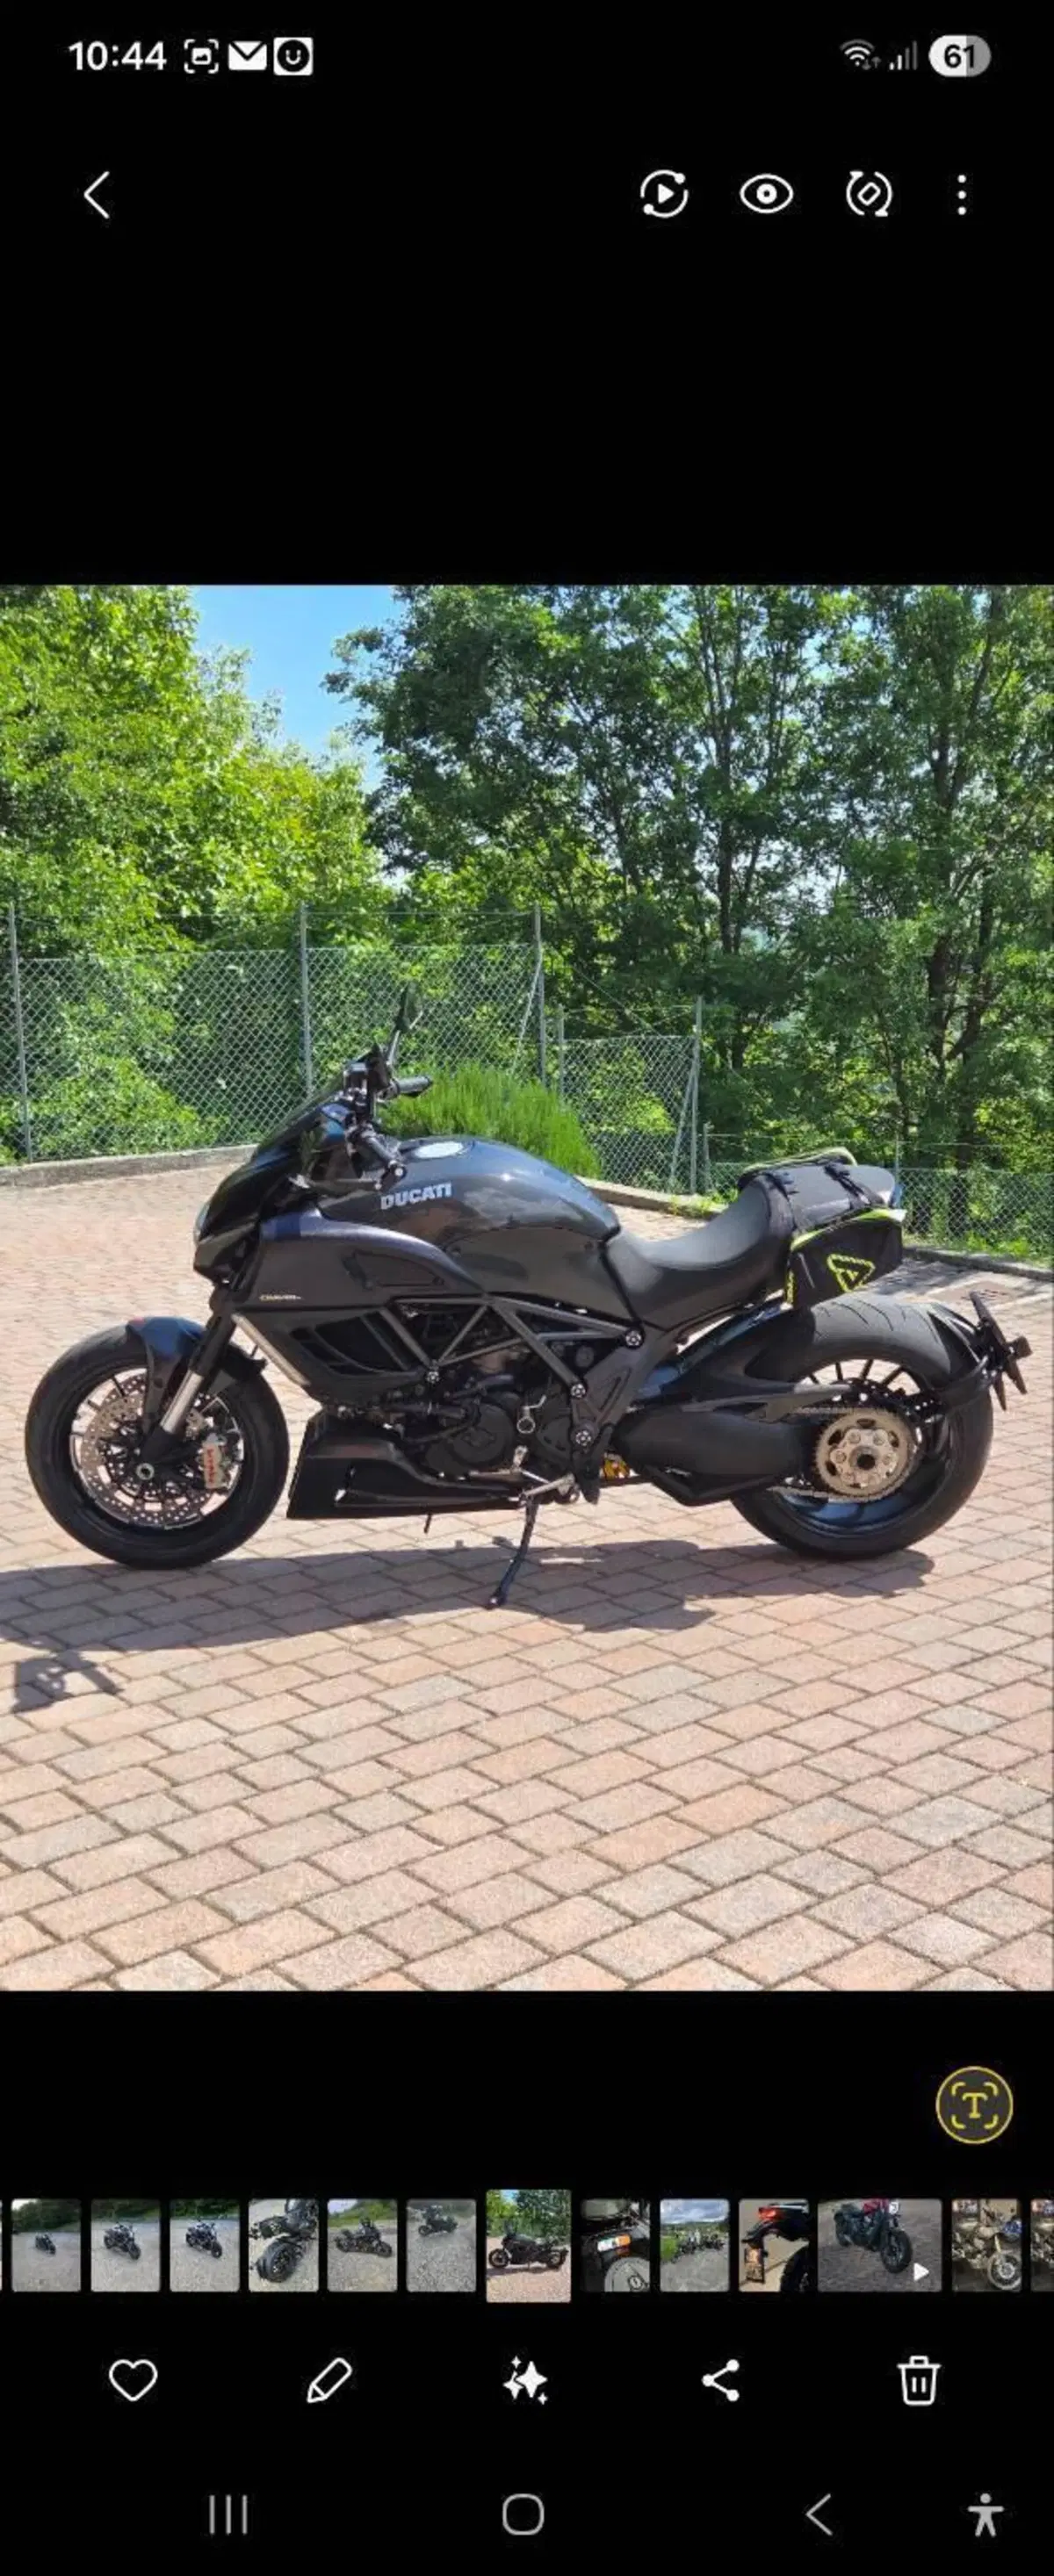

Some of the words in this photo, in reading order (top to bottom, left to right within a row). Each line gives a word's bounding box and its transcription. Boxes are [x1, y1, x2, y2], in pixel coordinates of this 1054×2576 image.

[69, 41, 167, 70] 10:44
[944, 45, 975, 68] 61
[380, 1183, 452, 1210] DUCATI
